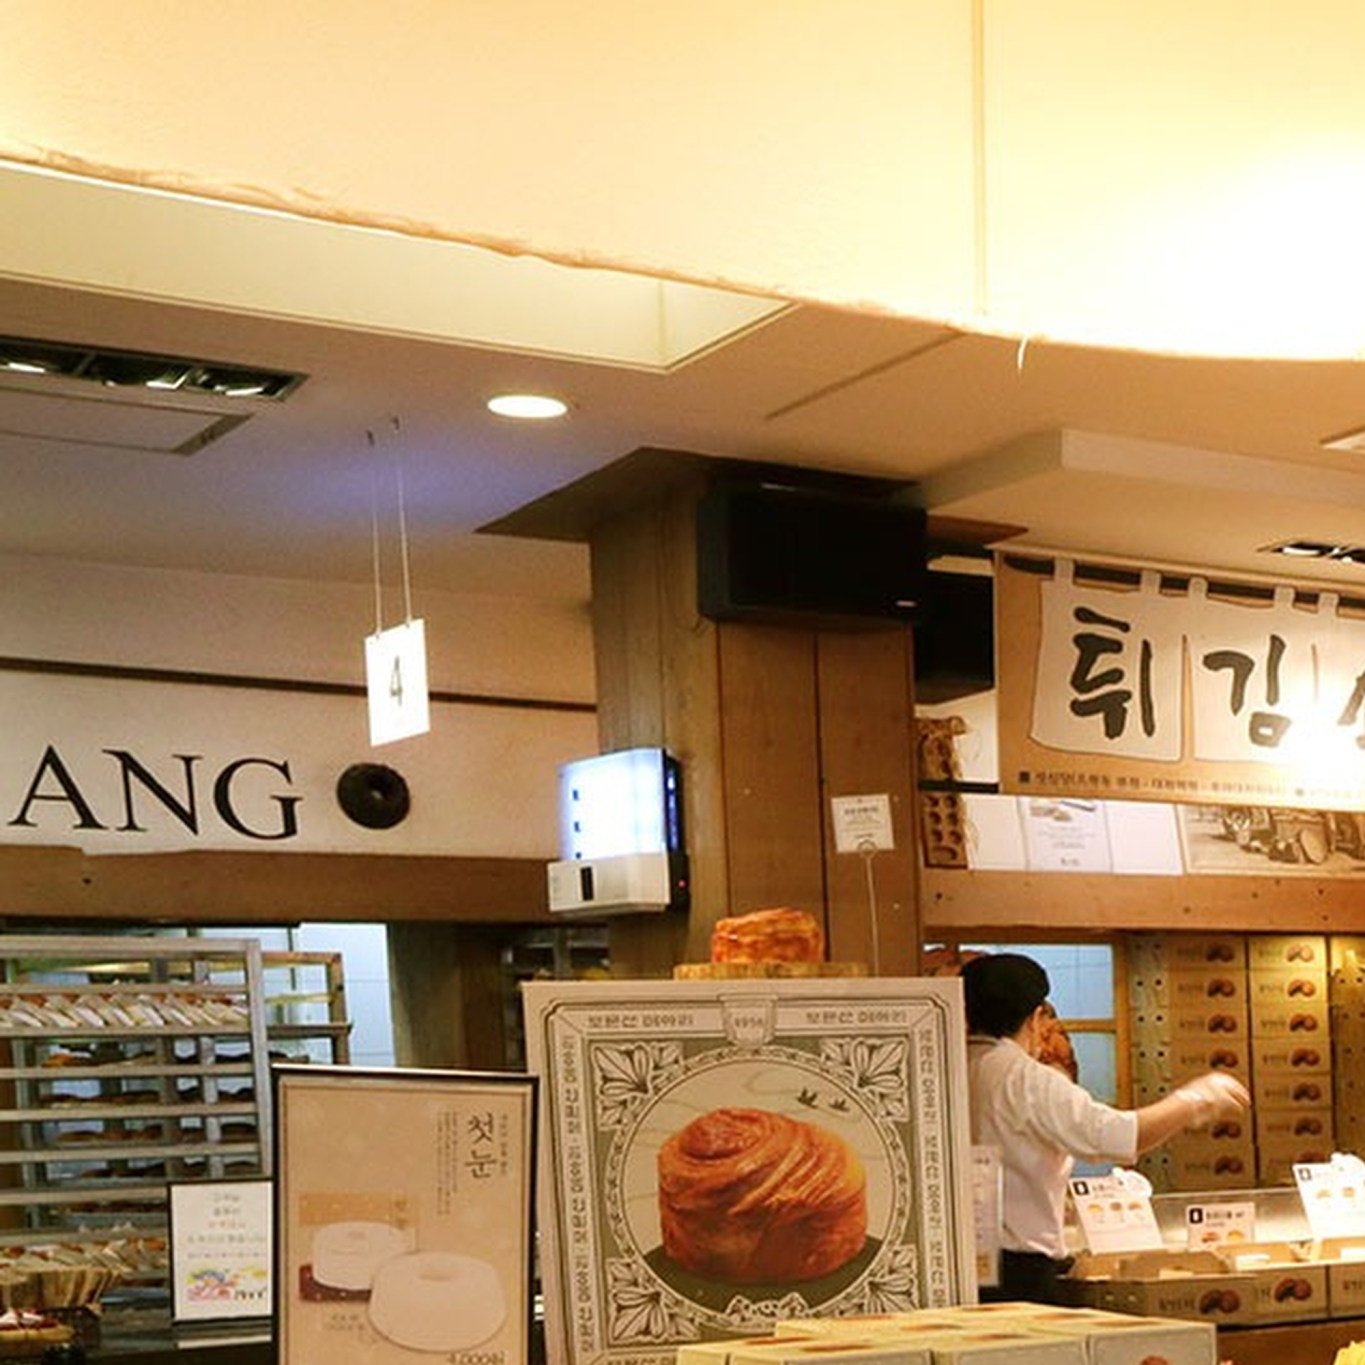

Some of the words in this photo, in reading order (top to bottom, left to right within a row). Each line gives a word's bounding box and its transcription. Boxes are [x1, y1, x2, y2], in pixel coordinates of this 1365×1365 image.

[389, 655, 402, 706] 4
[8, 745, 303, 840] ANG
[464, 1111, 498, 1179] 첫눈
